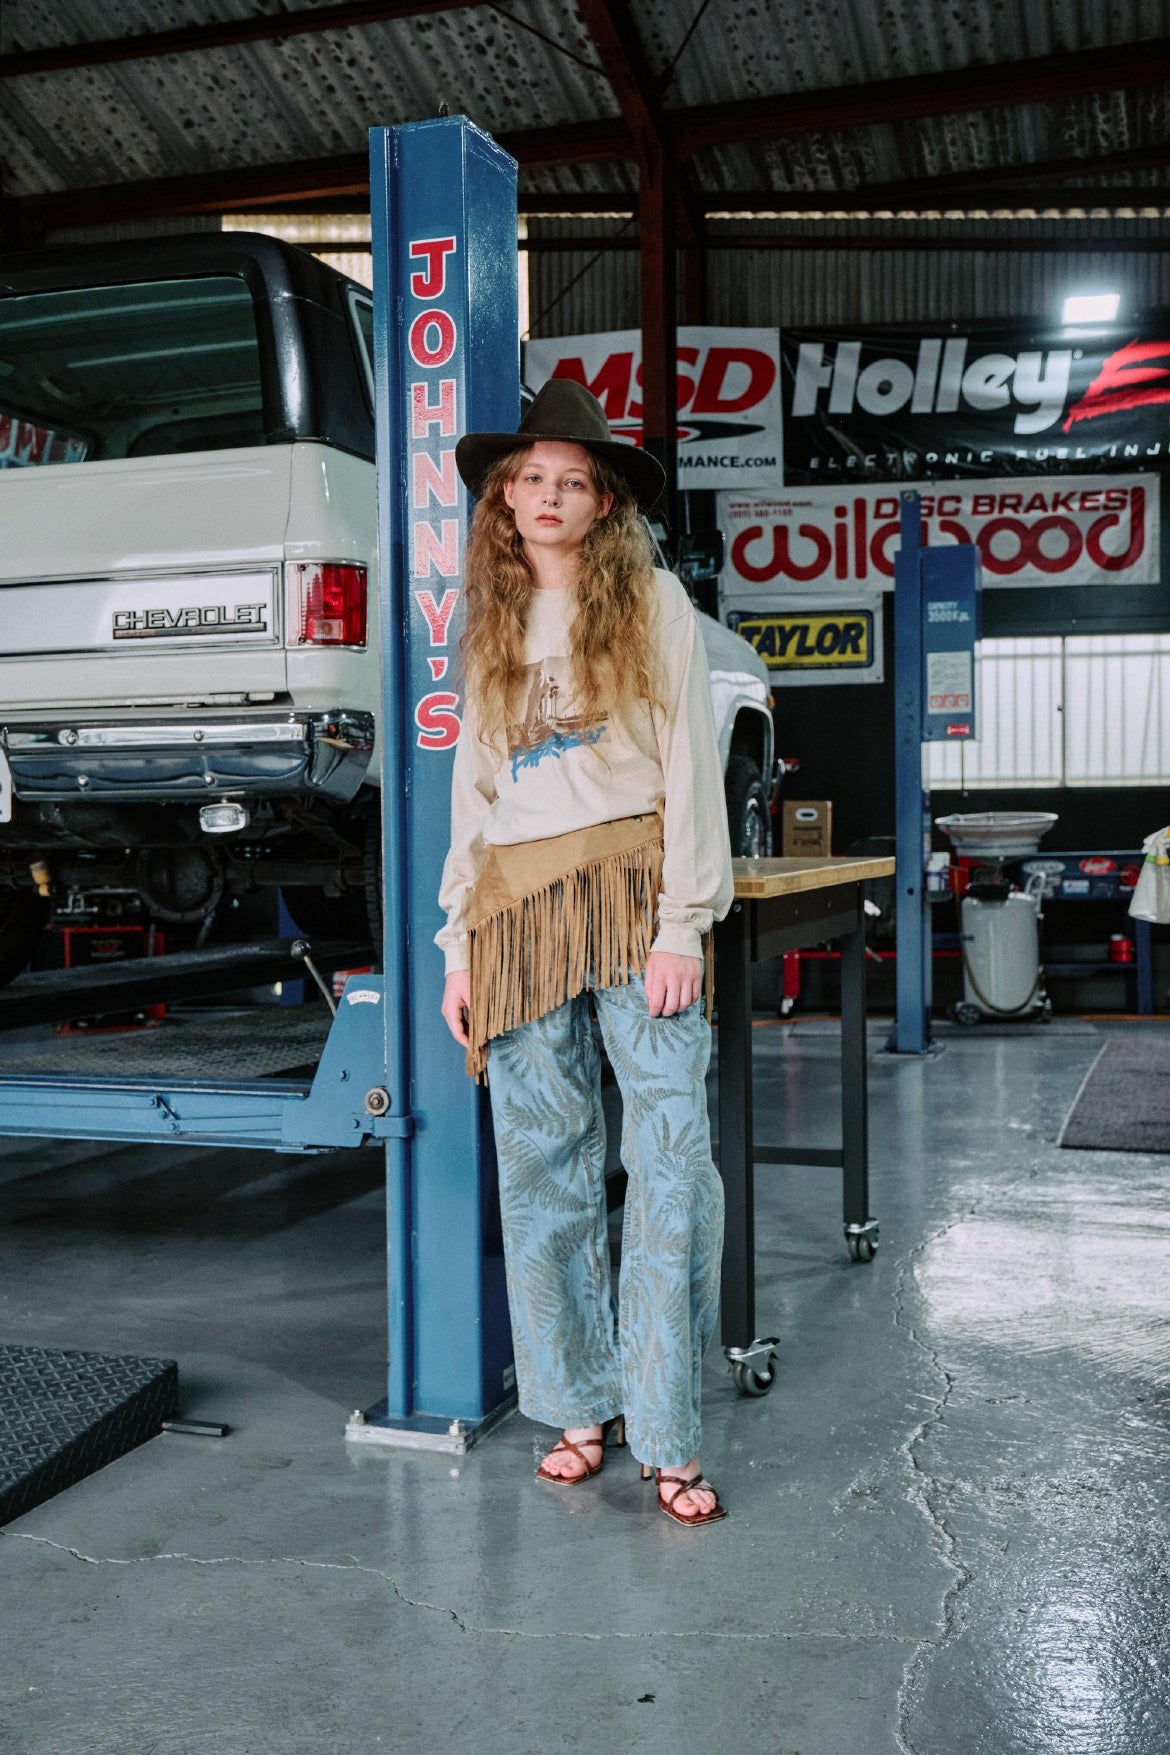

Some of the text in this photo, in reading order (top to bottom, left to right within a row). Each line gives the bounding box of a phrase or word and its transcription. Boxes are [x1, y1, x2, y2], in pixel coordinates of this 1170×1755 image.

[792, 338, 1073, 434] Holley
[809, 450, 994, 469] ELECTRONIC
[1109, 442, 1170, 458] INJ
[408, 235, 462, 751] JOHNNY'S
[873, 489, 1129, 520] DSC BRAKES
[113, 603, 267, 630] CHEVROLET
[740, 622, 864, 657] TAYLOR
